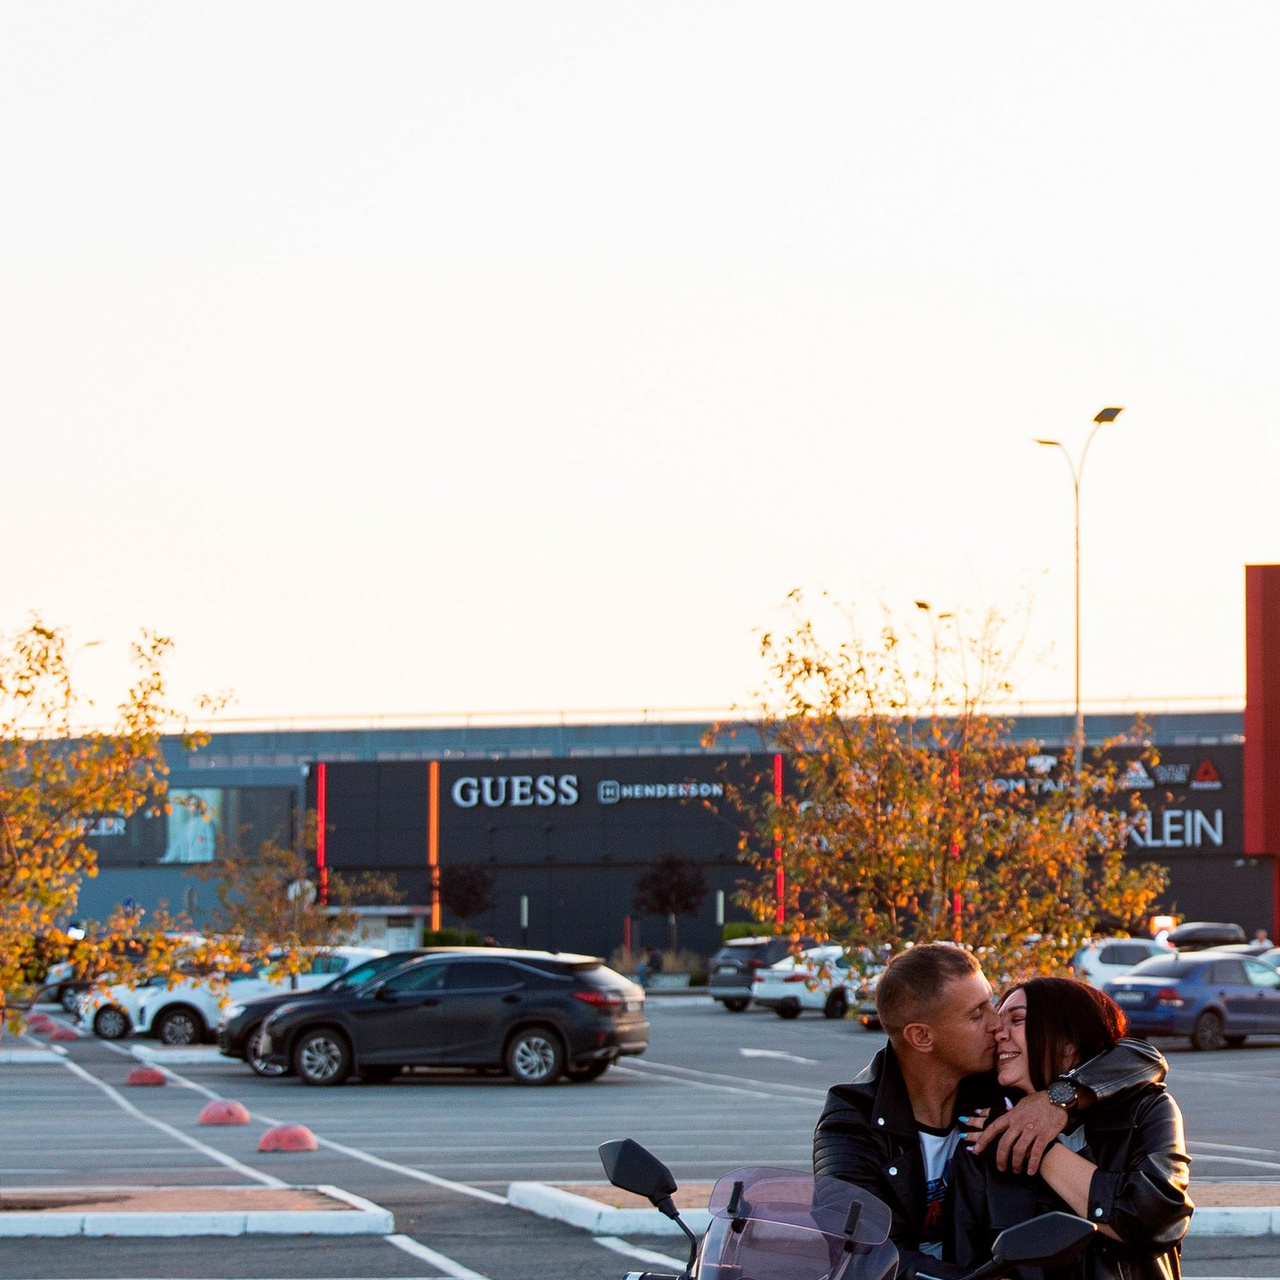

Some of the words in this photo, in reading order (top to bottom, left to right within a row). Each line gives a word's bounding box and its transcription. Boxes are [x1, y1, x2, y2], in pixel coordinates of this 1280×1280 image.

[452, 774, 579, 807] GUESS
[621, 783, 724, 800] HENDERSON
[1122, 808, 1223, 848] KLEIN
